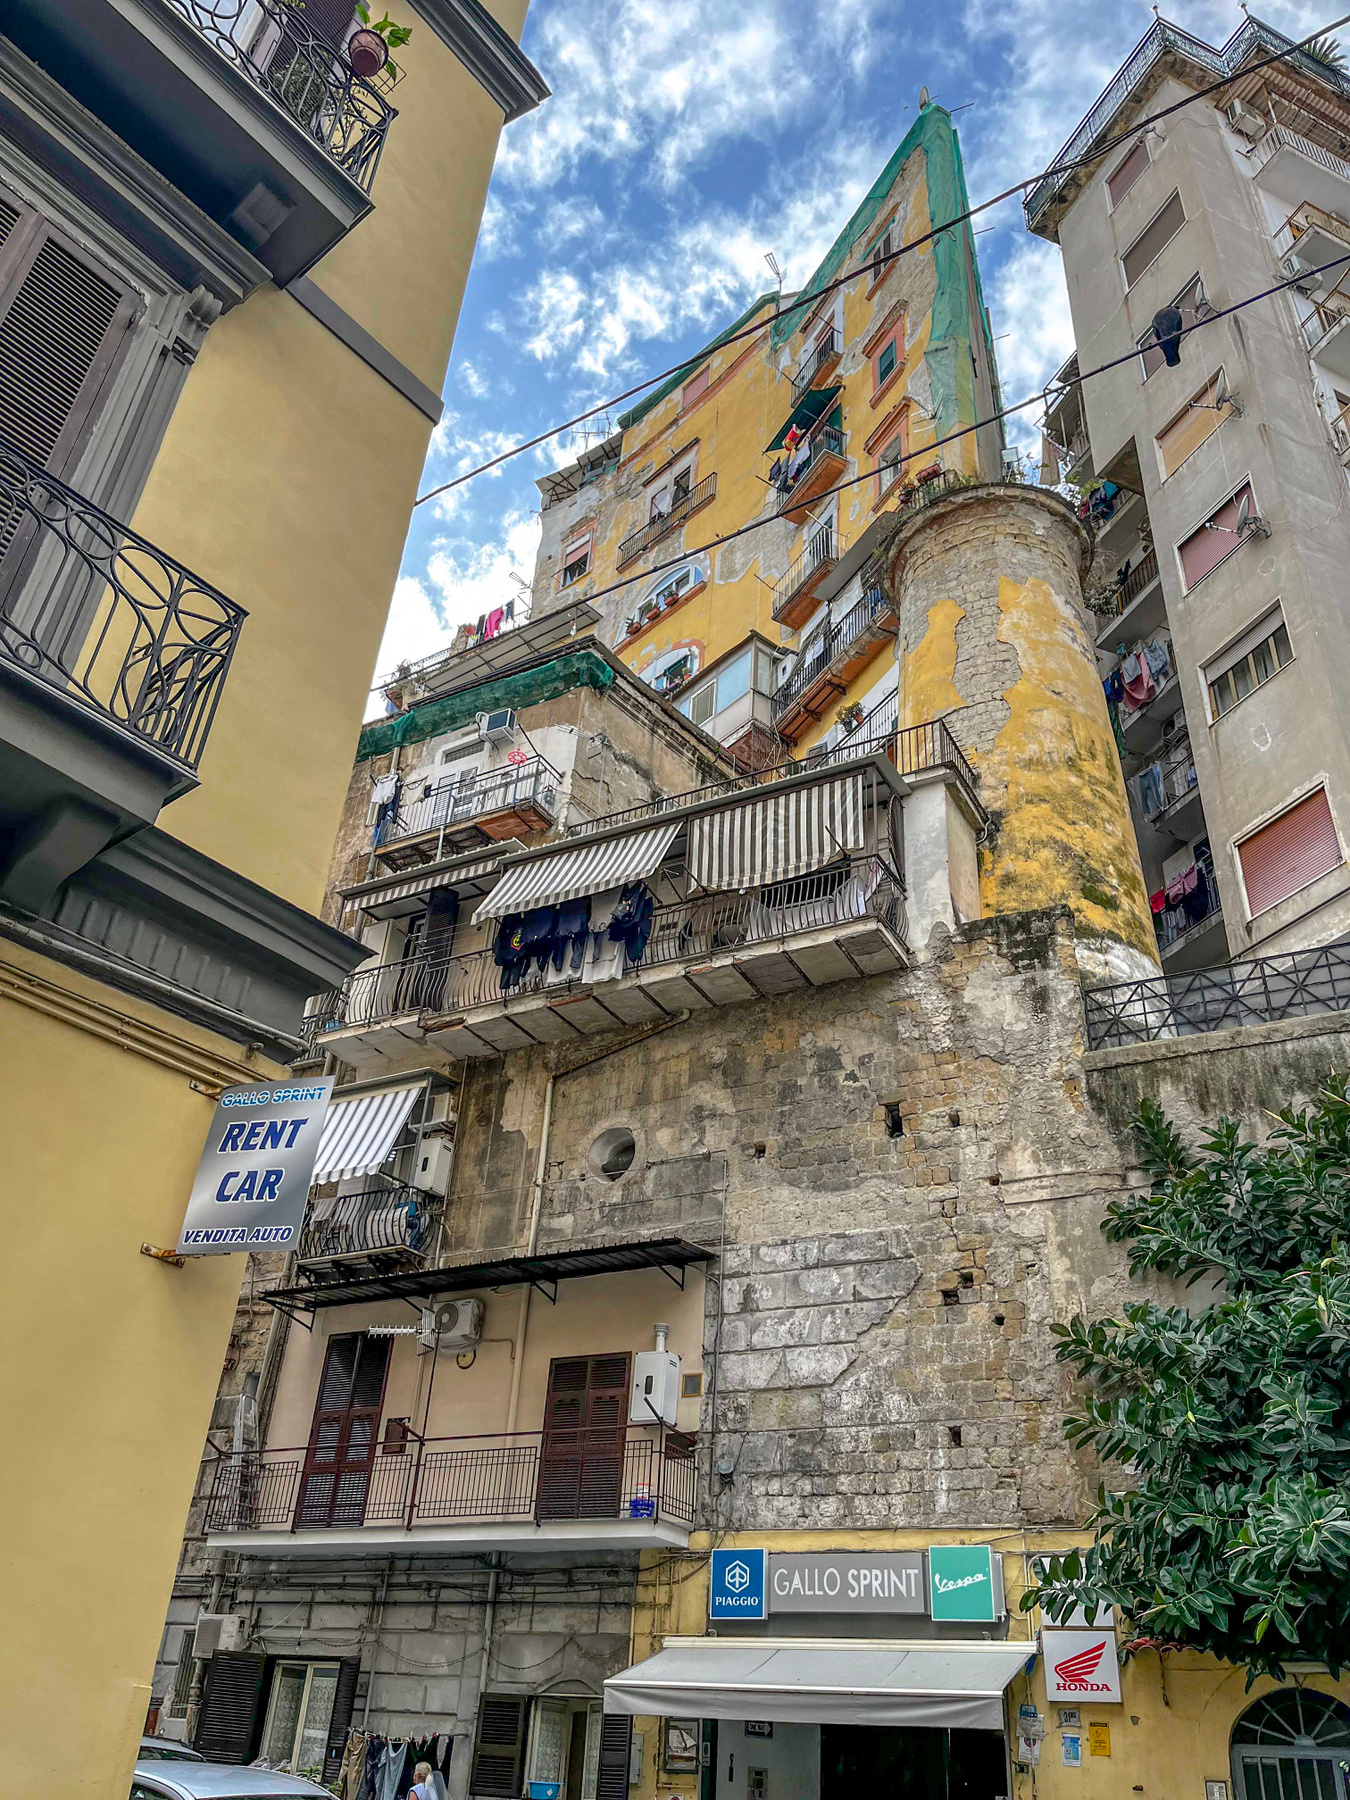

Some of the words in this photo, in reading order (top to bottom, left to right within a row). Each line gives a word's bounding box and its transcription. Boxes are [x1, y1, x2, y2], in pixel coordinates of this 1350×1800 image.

[222, 1091, 270, 1107] GALLO
[272, 1087, 327, 1104] SPRINT
[217, 1117, 309, 1154] RENT
[215, 1168, 285, 1203] CAR
[182, 1228, 248, 1245] VENDITA
[249, 1226, 294, 1243] AUTO
[773, 1567, 842, 1596] GALLO
[847, 1567, 919, 1598] SPRINT
[934, 1572, 988, 1594] Vespa
[714, 1595, 760, 1607] PIAGGIO
[1055, 1682, 1112, 1691] HONDA
